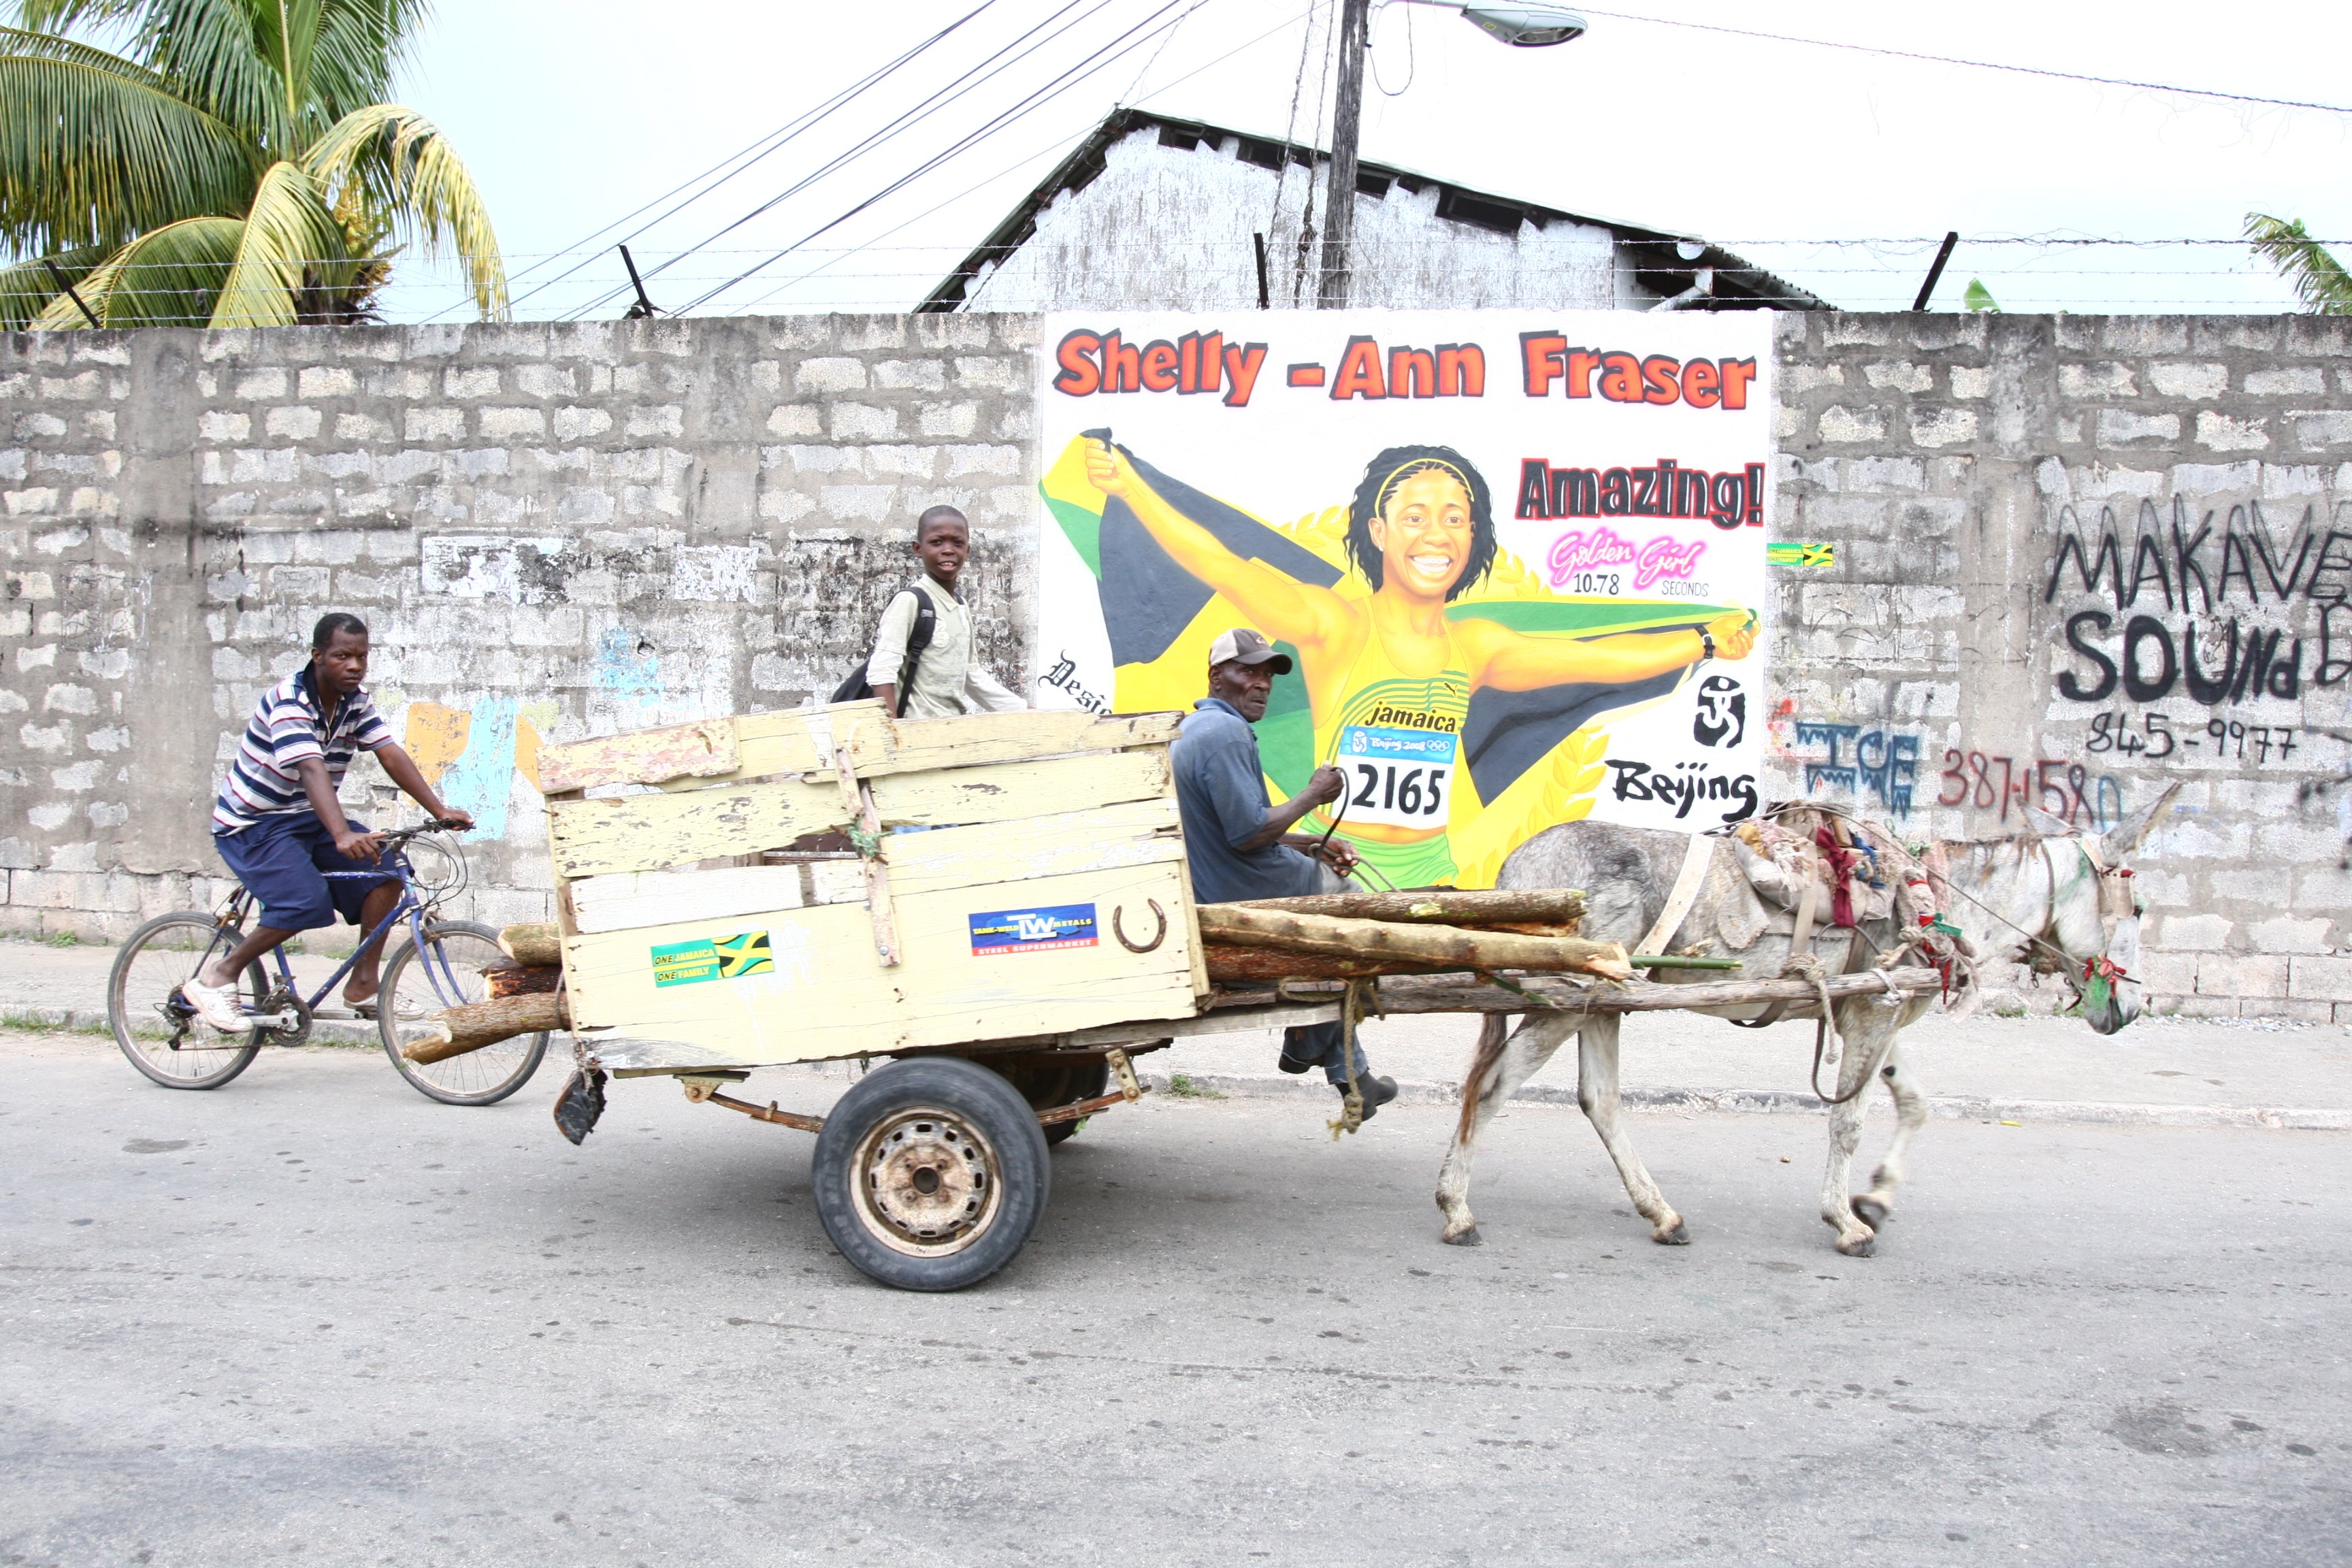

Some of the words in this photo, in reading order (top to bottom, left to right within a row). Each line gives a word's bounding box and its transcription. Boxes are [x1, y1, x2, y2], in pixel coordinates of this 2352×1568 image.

[1052, 327, 1268, 407] Shelly
[1519, 330, 1757, 410] Fraser
[1515, 457, 1765, 530] Amazing!
[1550, 532, 1633, 585] Golden
[1637, 538, 1703, 587] Girl
[1573, 573, 1620, 595] 10.78
[1661, 580, 1710, 597] SECONDS
[1365, 700, 1456, 733] jamaica
[1369, 737, 1402, 751] Beijing
[1402, 741, 1426, 751] 2008
[2085, 712, 2296, 763] 845-9977
[1351, 764, 1446, 815] 2165
[1604, 759, 1759, 823] Beijing
[1053, 918, 1092, 928] METALS
[654, 955, 674, 965] ONE
[674, 949, 715, 962] JAMAICA
[978, 947, 1009, 956] STEEL
[1013, 939, 1092, 953] SUPERMARKET
[657, 971, 676, 981] ONE
[678, 966, 710, 979] FAMILY
